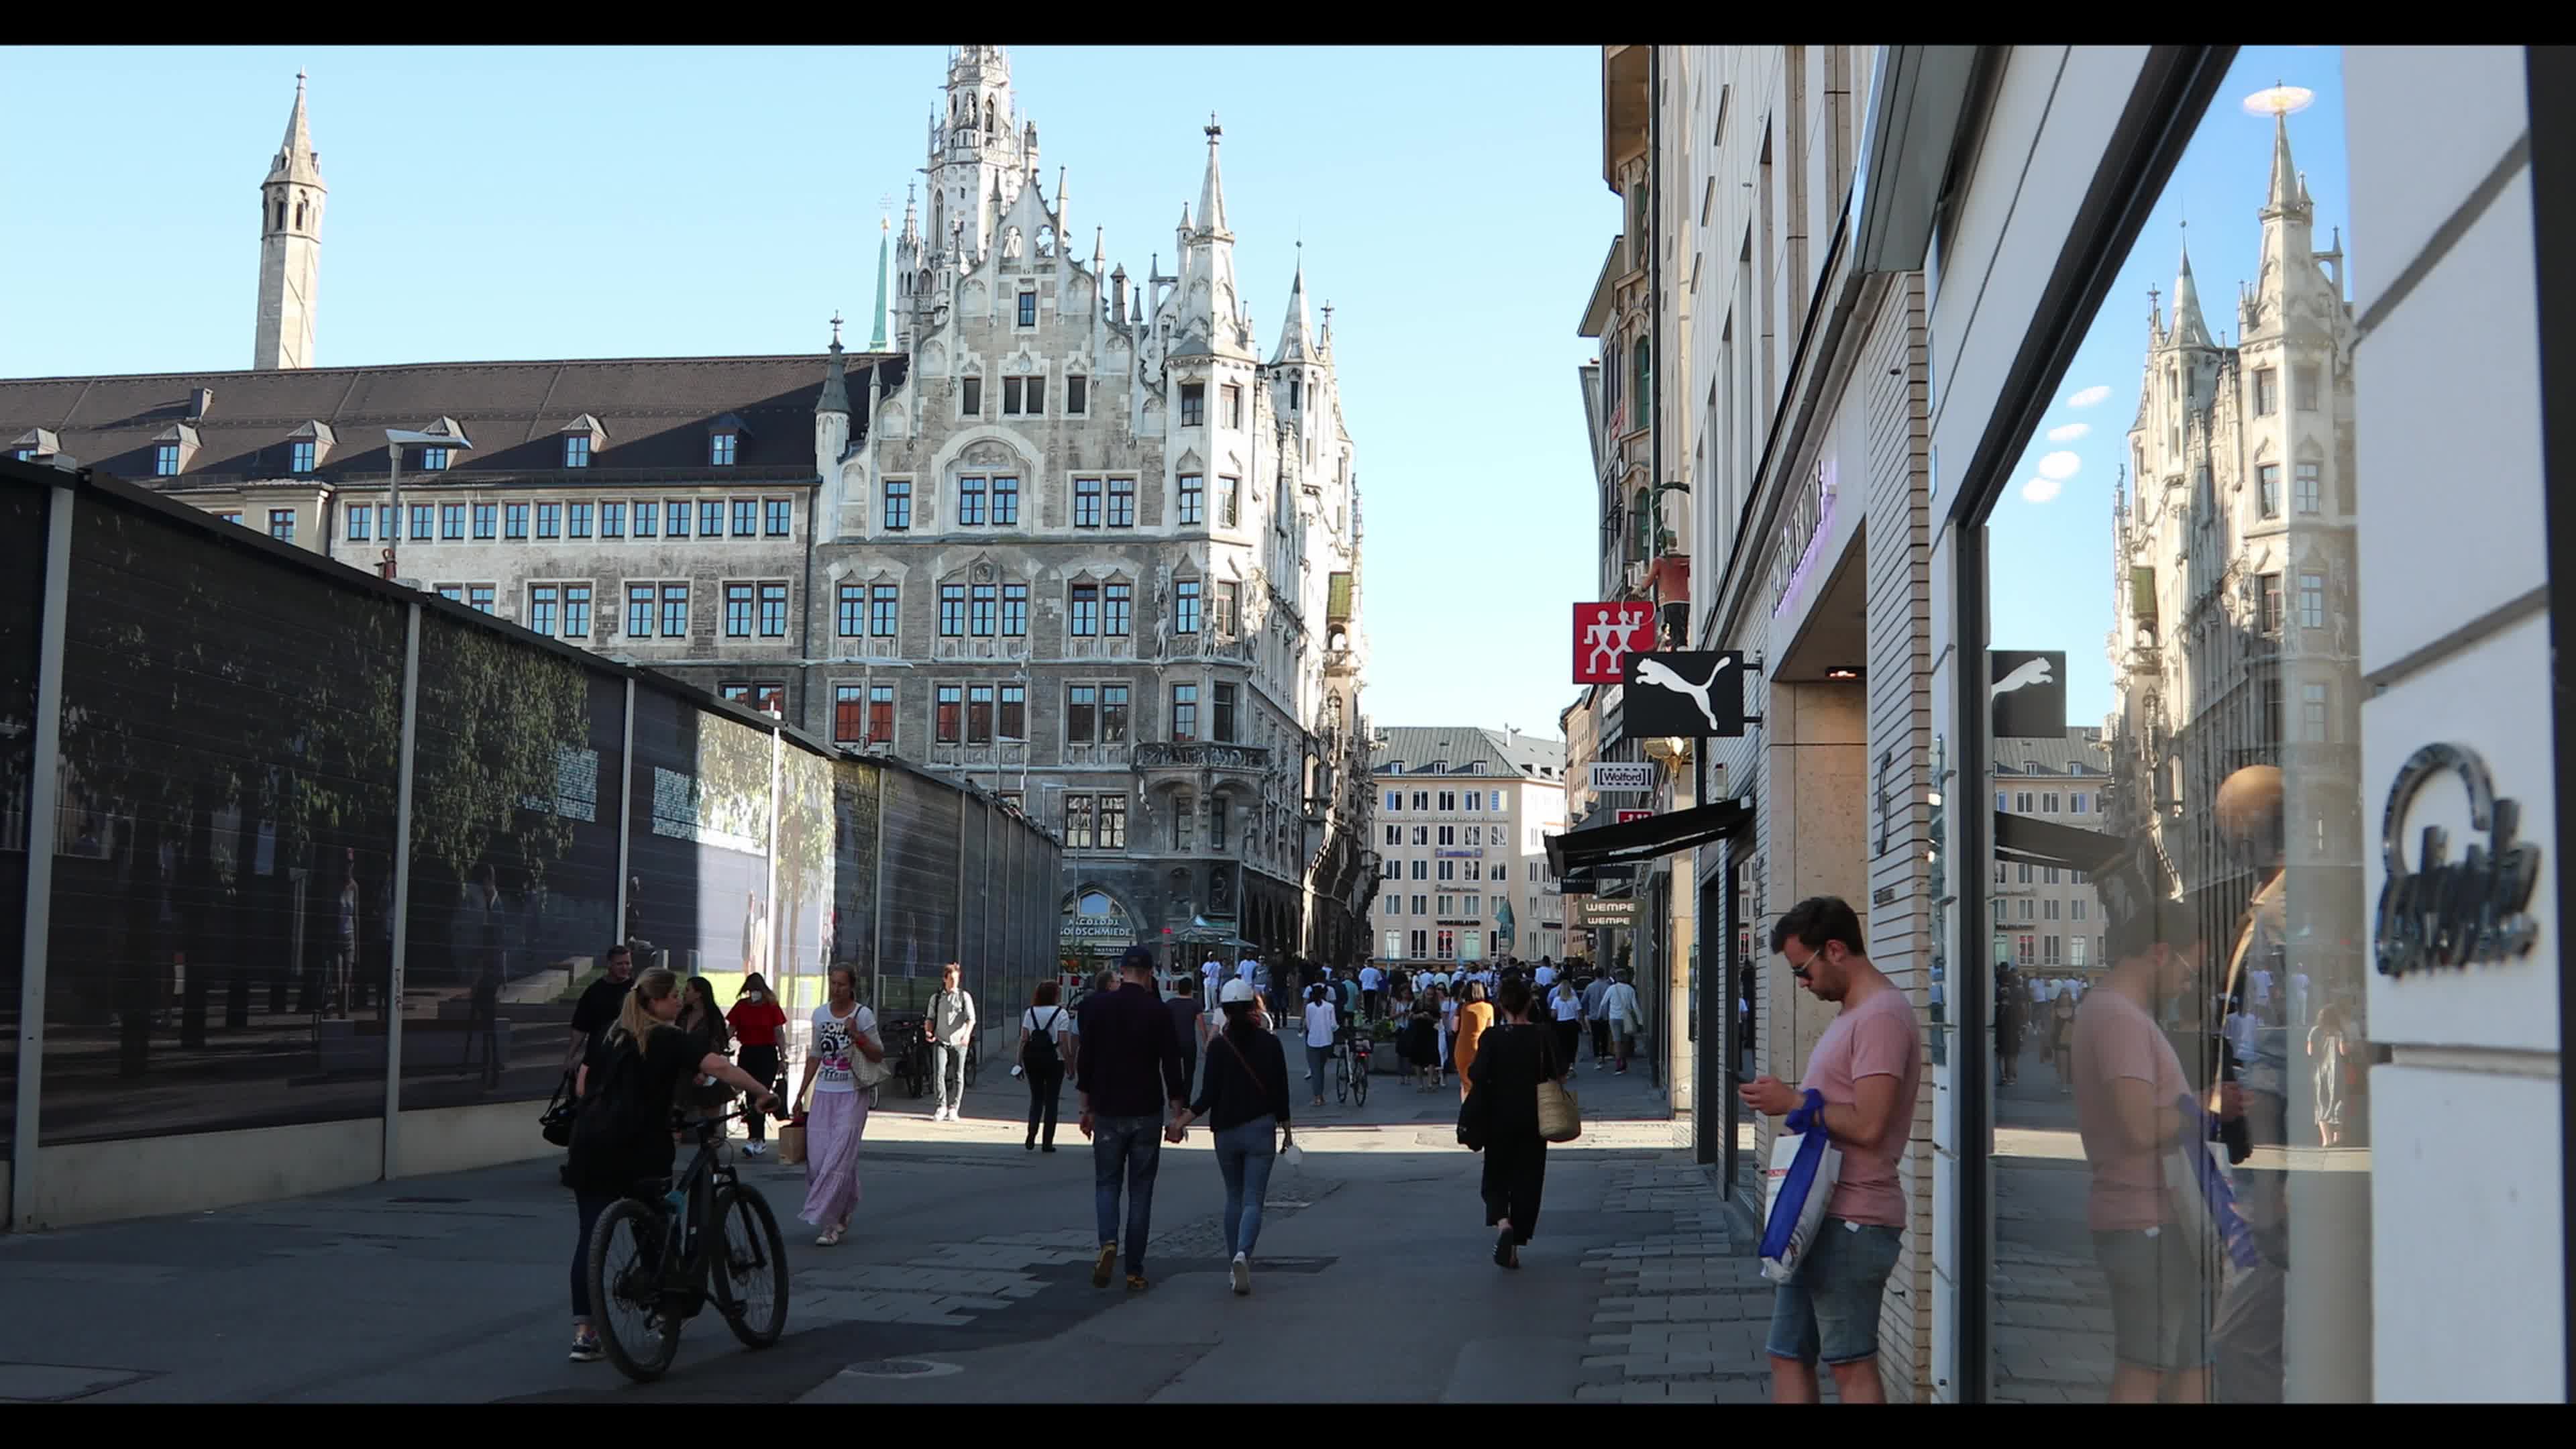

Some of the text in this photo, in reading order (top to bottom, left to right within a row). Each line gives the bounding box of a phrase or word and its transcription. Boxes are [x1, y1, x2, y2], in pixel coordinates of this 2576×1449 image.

[1603, 772, 1642, 782] Wolford
[1585, 903, 1635, 912] WEMPE
[1587, 917, 1631, 925] WEMPE
